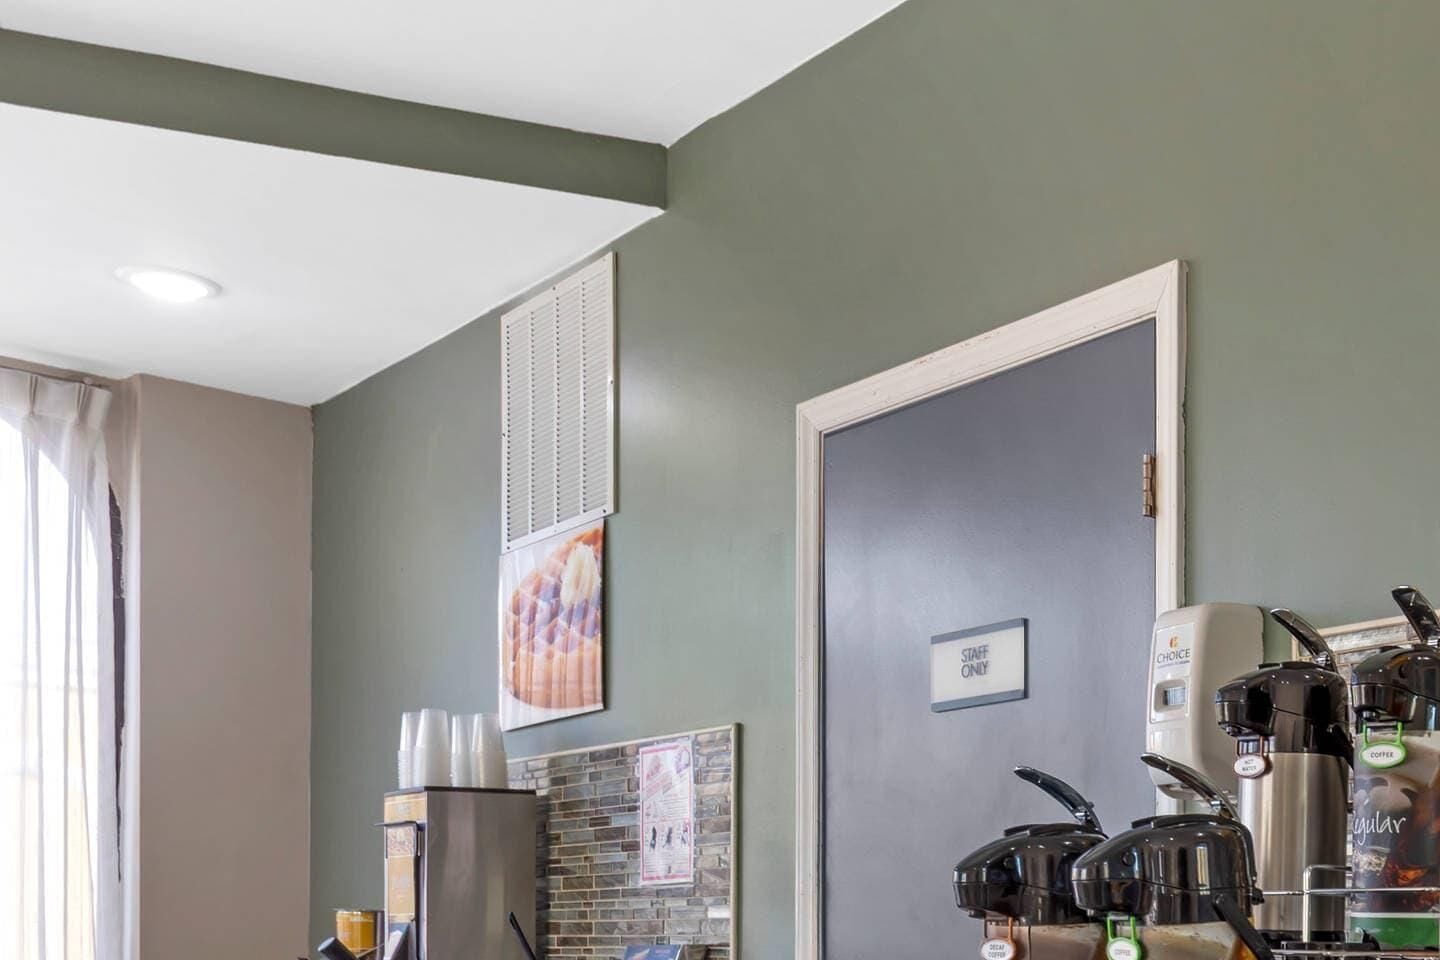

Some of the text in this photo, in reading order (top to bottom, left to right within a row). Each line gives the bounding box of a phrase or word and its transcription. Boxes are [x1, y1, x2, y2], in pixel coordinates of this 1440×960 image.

[961, 645, 989, 663] STAFF
[1156, 648, 1191, 664] CHOICE
[961, 661, 989, 678] ONLY
[1370, 751, 1394, 759] COFFEE
